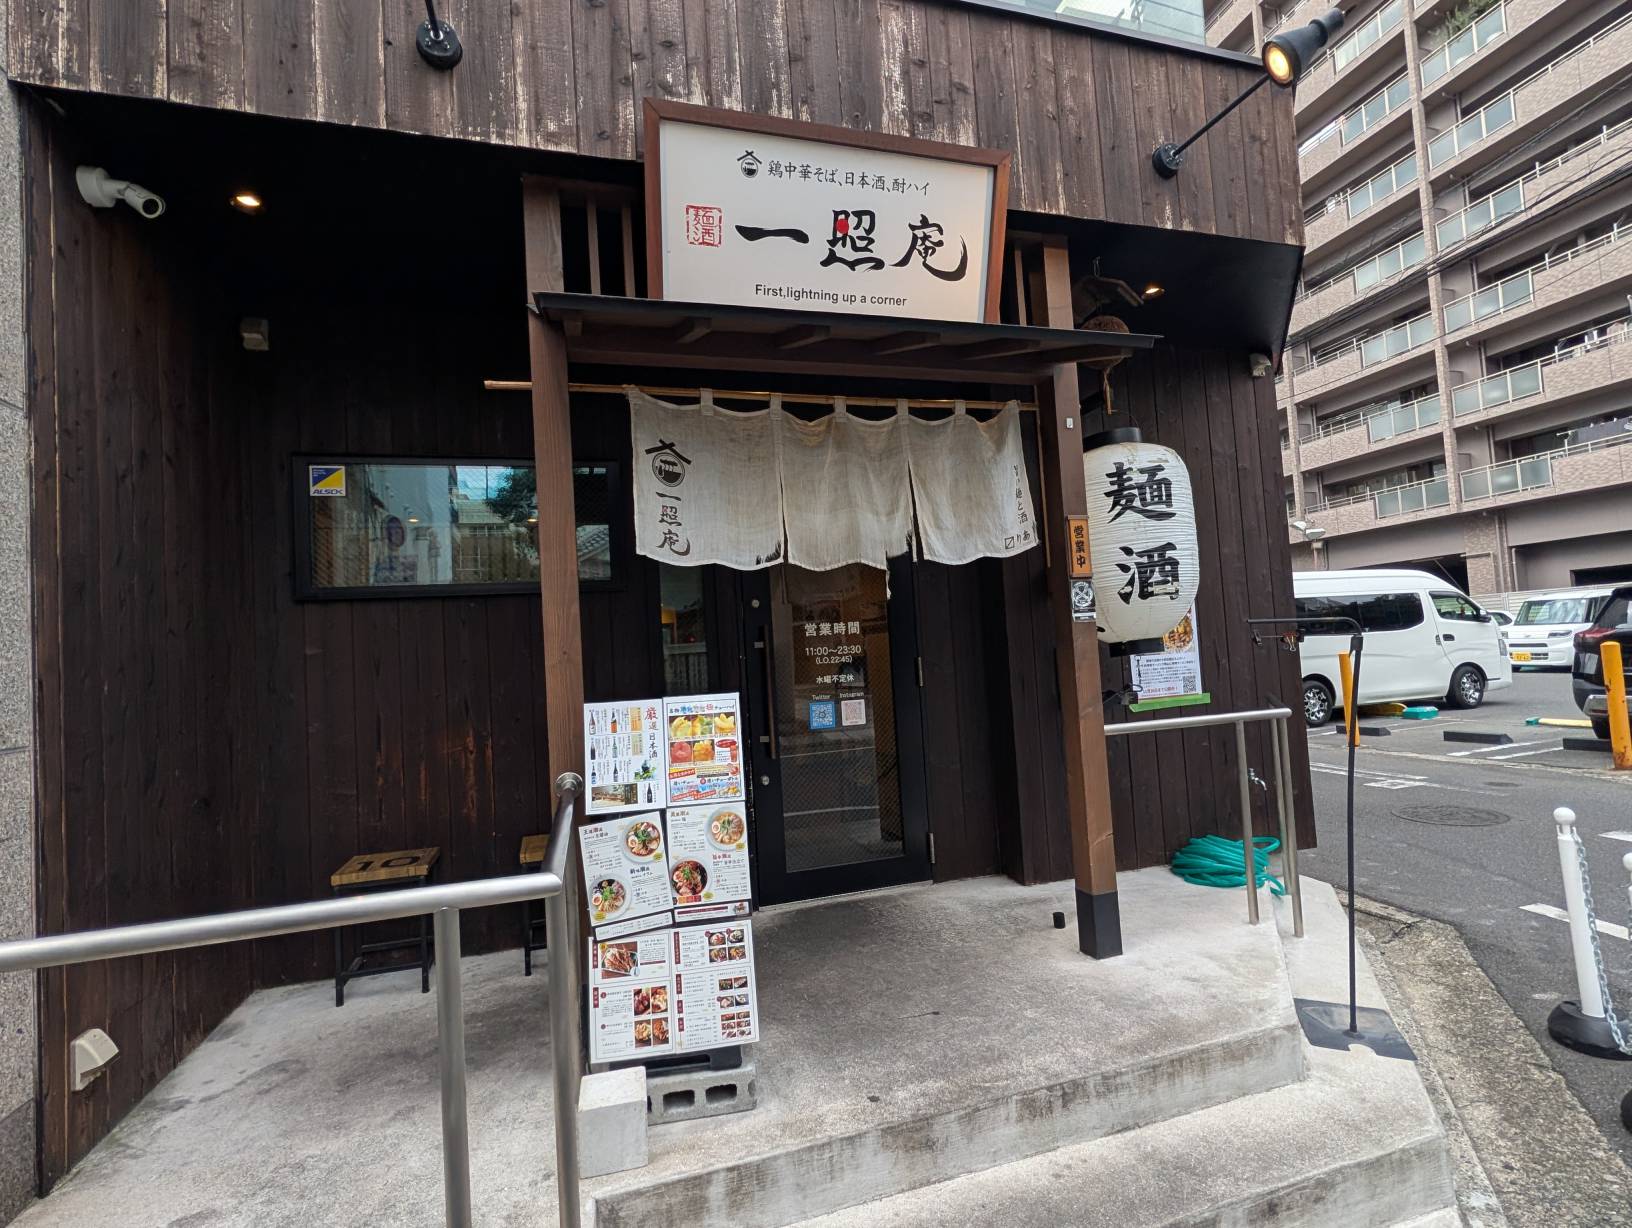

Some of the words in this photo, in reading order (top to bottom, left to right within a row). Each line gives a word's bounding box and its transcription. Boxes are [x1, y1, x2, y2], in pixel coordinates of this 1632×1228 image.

[767, 160, 930, 196] 鶏中華そば、日本酒、酎ハイ
[735, 208, 969, 282] 一照庵
[755, 284, 839, 304] First,lightning
[842, 293, 857, 305] up
[860, 295, 867, 304] a
[870, 296, 907, 306] corner
[655, 491, 691, 556] 一照庵
[1074, 525, 1086, 568] 営業中
[804, 621, 860, 637] 営業時間
[815, 673, 855, 684] 水曜不定休
